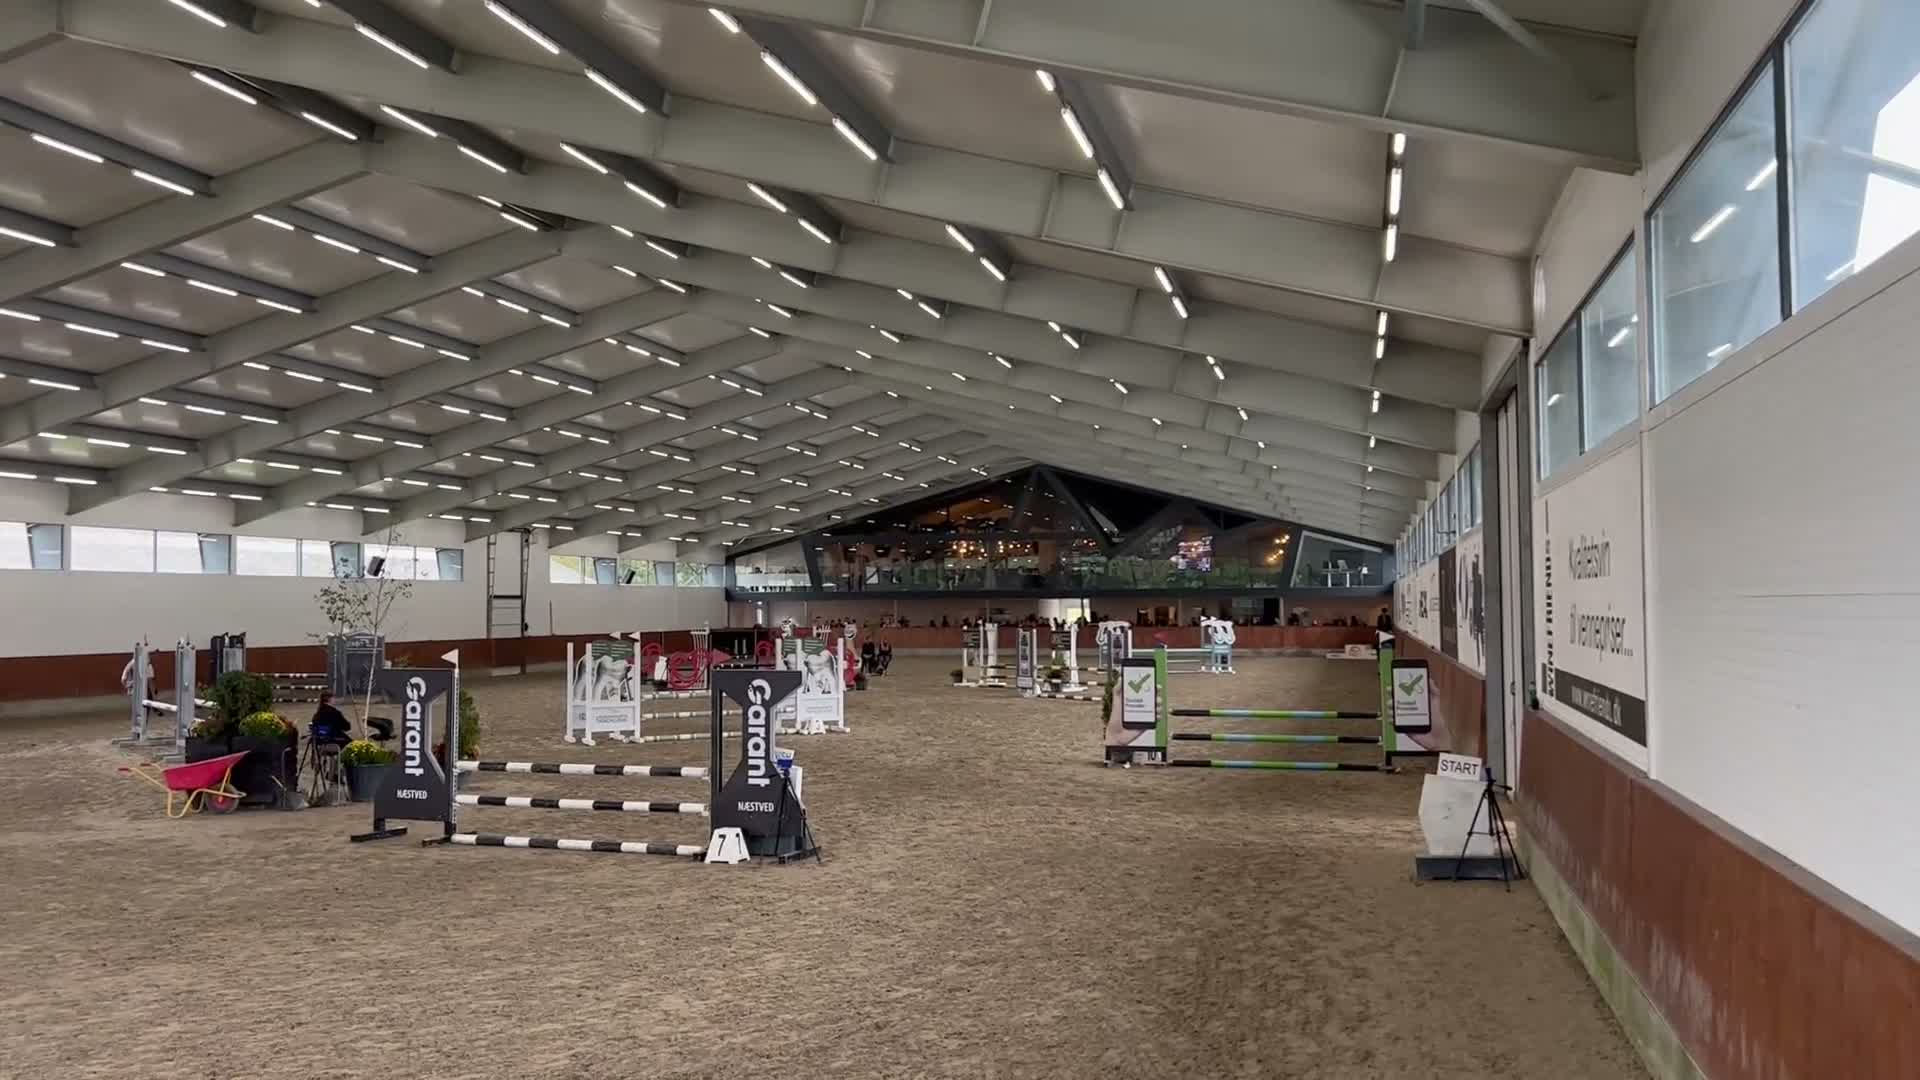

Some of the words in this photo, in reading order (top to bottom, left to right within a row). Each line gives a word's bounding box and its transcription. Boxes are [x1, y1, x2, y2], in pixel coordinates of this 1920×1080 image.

[405, 677, 426, 776] Garant
[747, 679, 771, 787] Garant
[1440, 760, 1479, 775] START
[397, 789, 427, 799] NÆSTVED
[738, 802, 774, 812] NÆSTVED
[718, 834, 727, 856] 7
